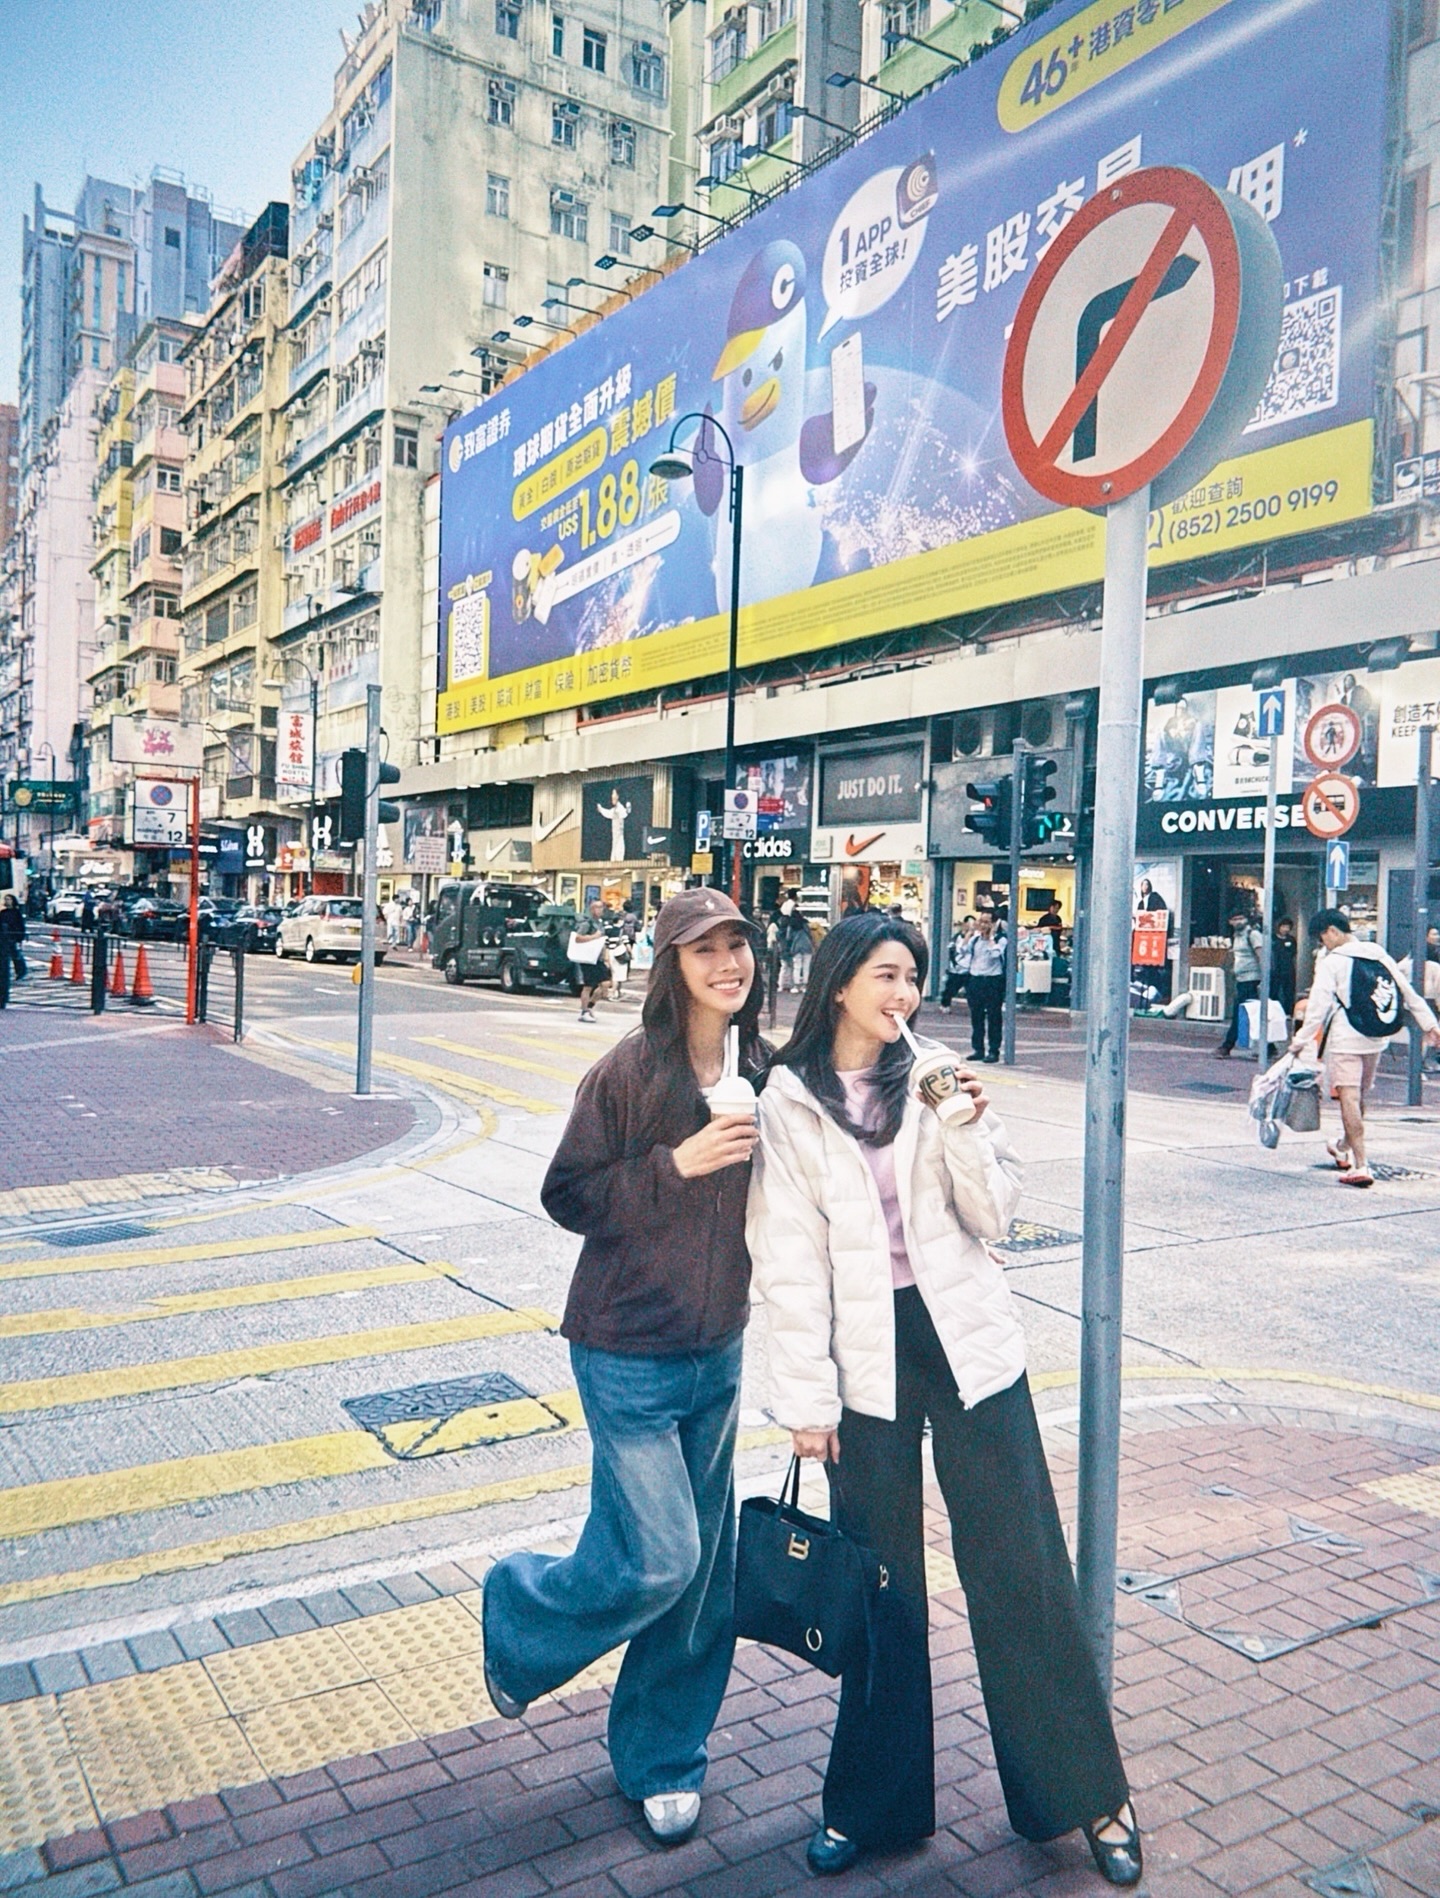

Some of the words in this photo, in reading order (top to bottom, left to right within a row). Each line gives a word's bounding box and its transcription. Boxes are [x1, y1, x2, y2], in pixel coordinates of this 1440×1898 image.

[839, 226, 850, 267] 1
[855, 216, 892, 258] APP
[839, 239, 908, 294] 投資全球!
[1171, 477, 1243, 516] 歡迎查詢
[1169, 509, 1221, 544] (852)
[1226, 494, 1281, 529] 2500
[1287, 479, 1338, 512] 9199
[558, 512, 579, 541] US$
[837, 778, 865, 800] JUST
[867, 776, 885, 797] DO
[167, 812, 176, 823] 7
[700, 814, 709, 837] P
[745, 814, 751, 824] 7
[1161, 804, 1307, 834] CONVERSE
[167, 831, 183, 842] 12
[745, 829, 755, 838] 12
